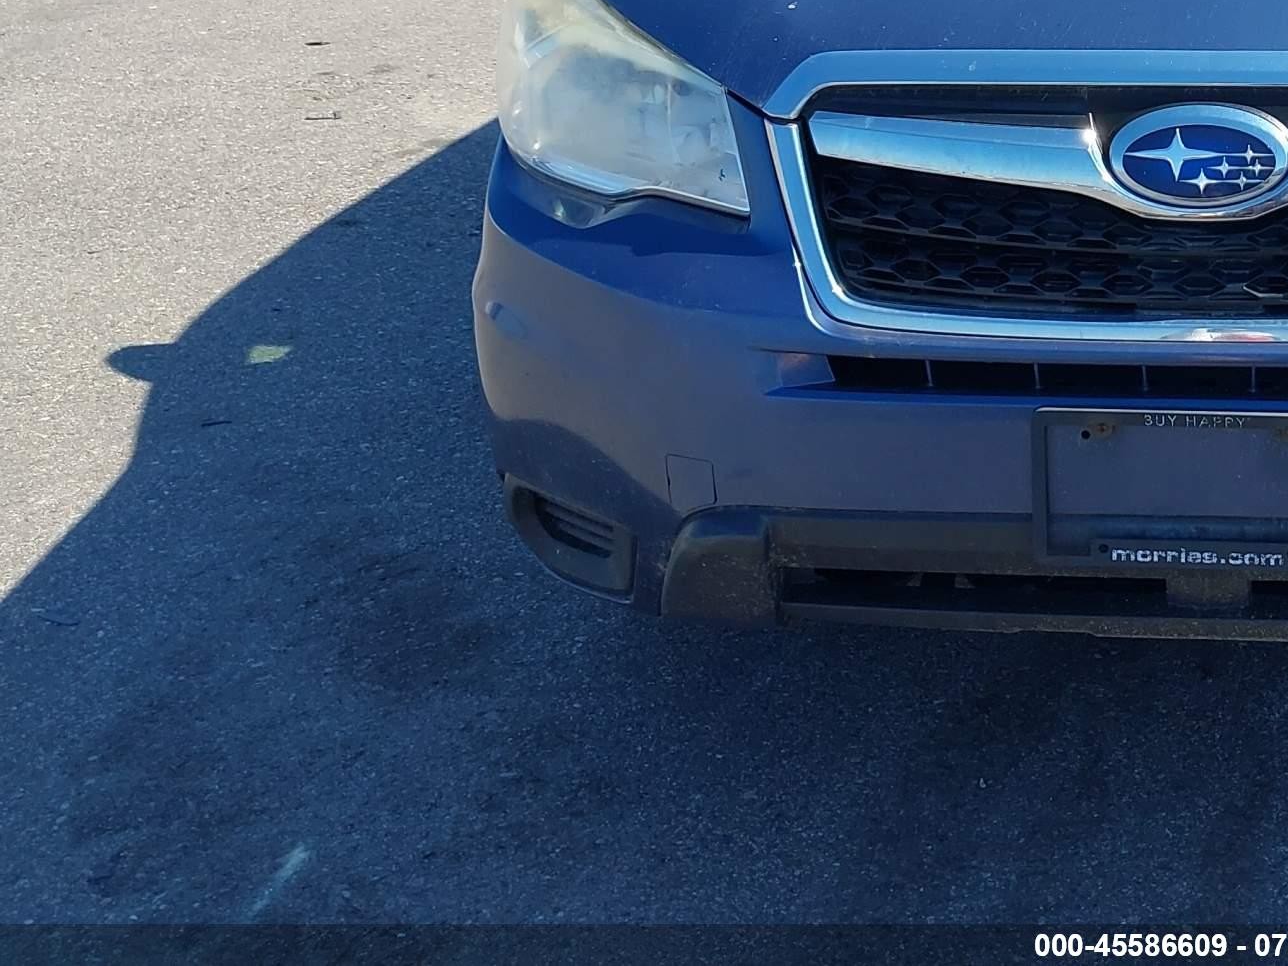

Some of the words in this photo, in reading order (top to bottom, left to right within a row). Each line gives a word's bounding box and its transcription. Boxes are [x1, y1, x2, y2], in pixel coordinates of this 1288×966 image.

[1143, 413, 1177, 427] BUY
[1185, 415, 1246, 428] HAPPY
[1111, 547, 1284, 566] morries.com
